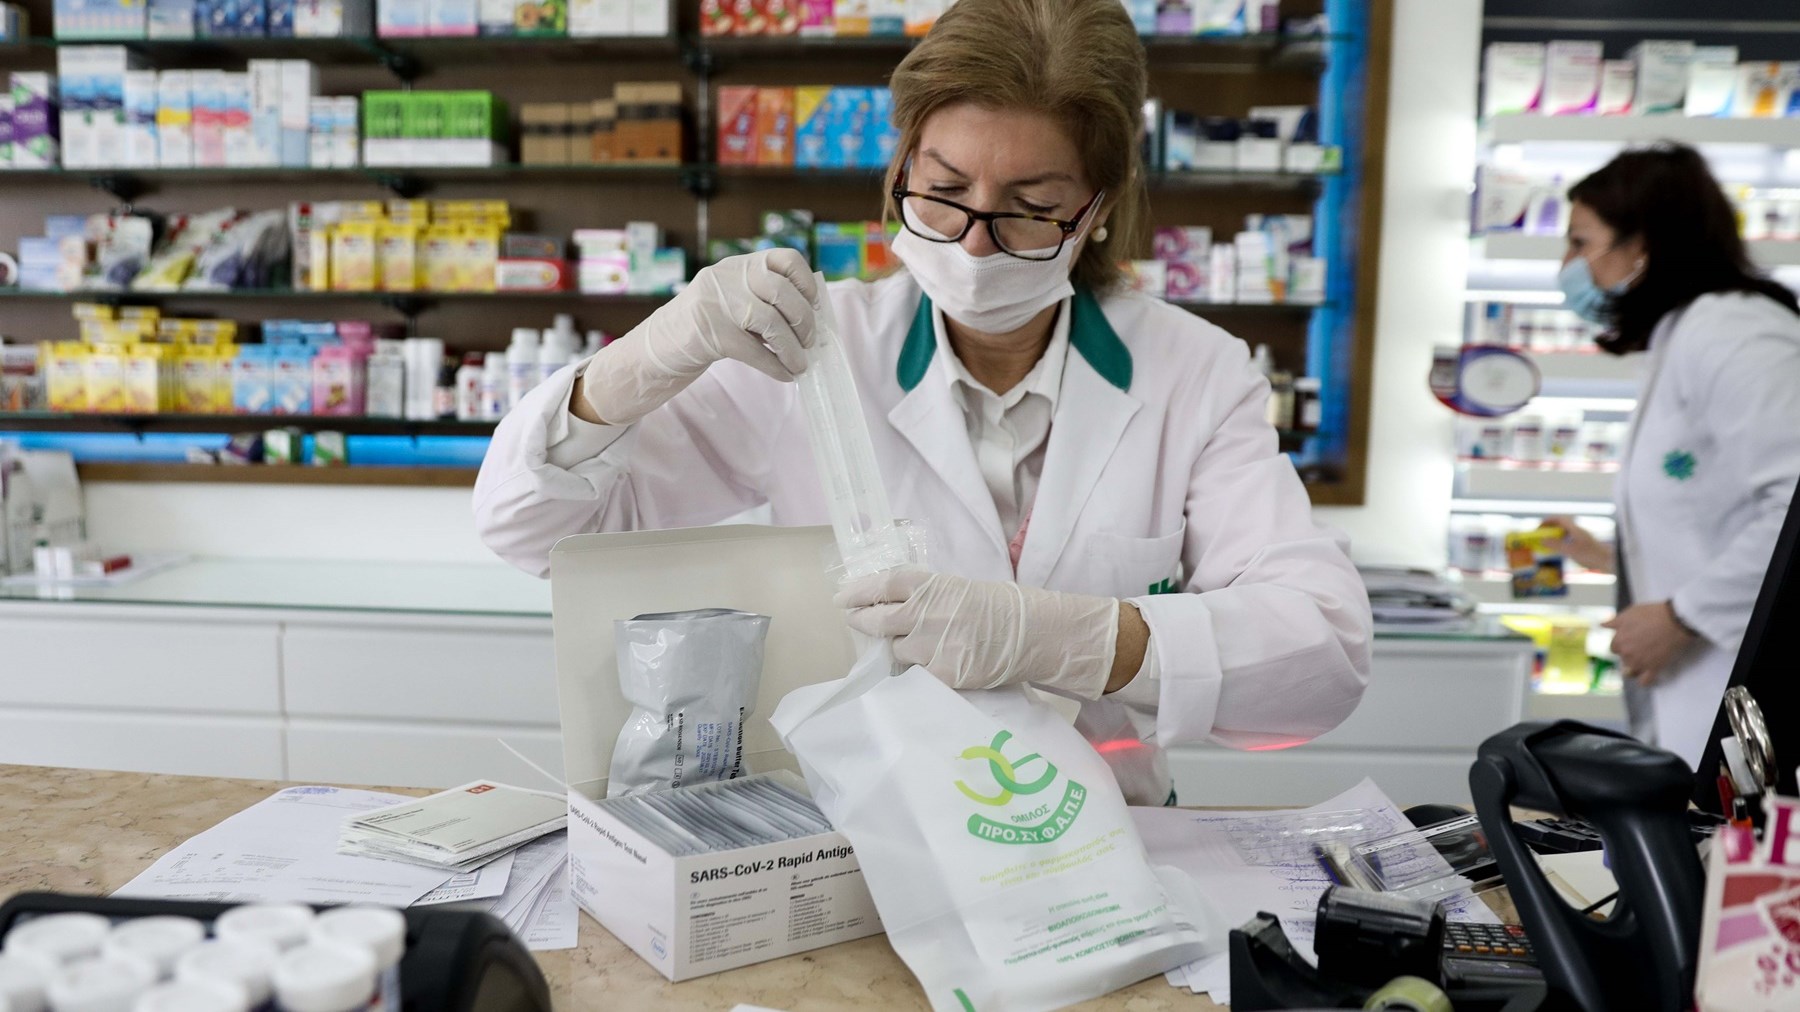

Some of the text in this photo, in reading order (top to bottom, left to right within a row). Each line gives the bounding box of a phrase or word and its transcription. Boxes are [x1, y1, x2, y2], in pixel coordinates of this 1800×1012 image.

[1010, 803, 1051, 824] ΟΜΙΛΟΣ
[690, 860, 774, 884] SARS-CoV-2
[778, 852, 814, 870] Rapid
[816, 845, 854, 861] Antige
